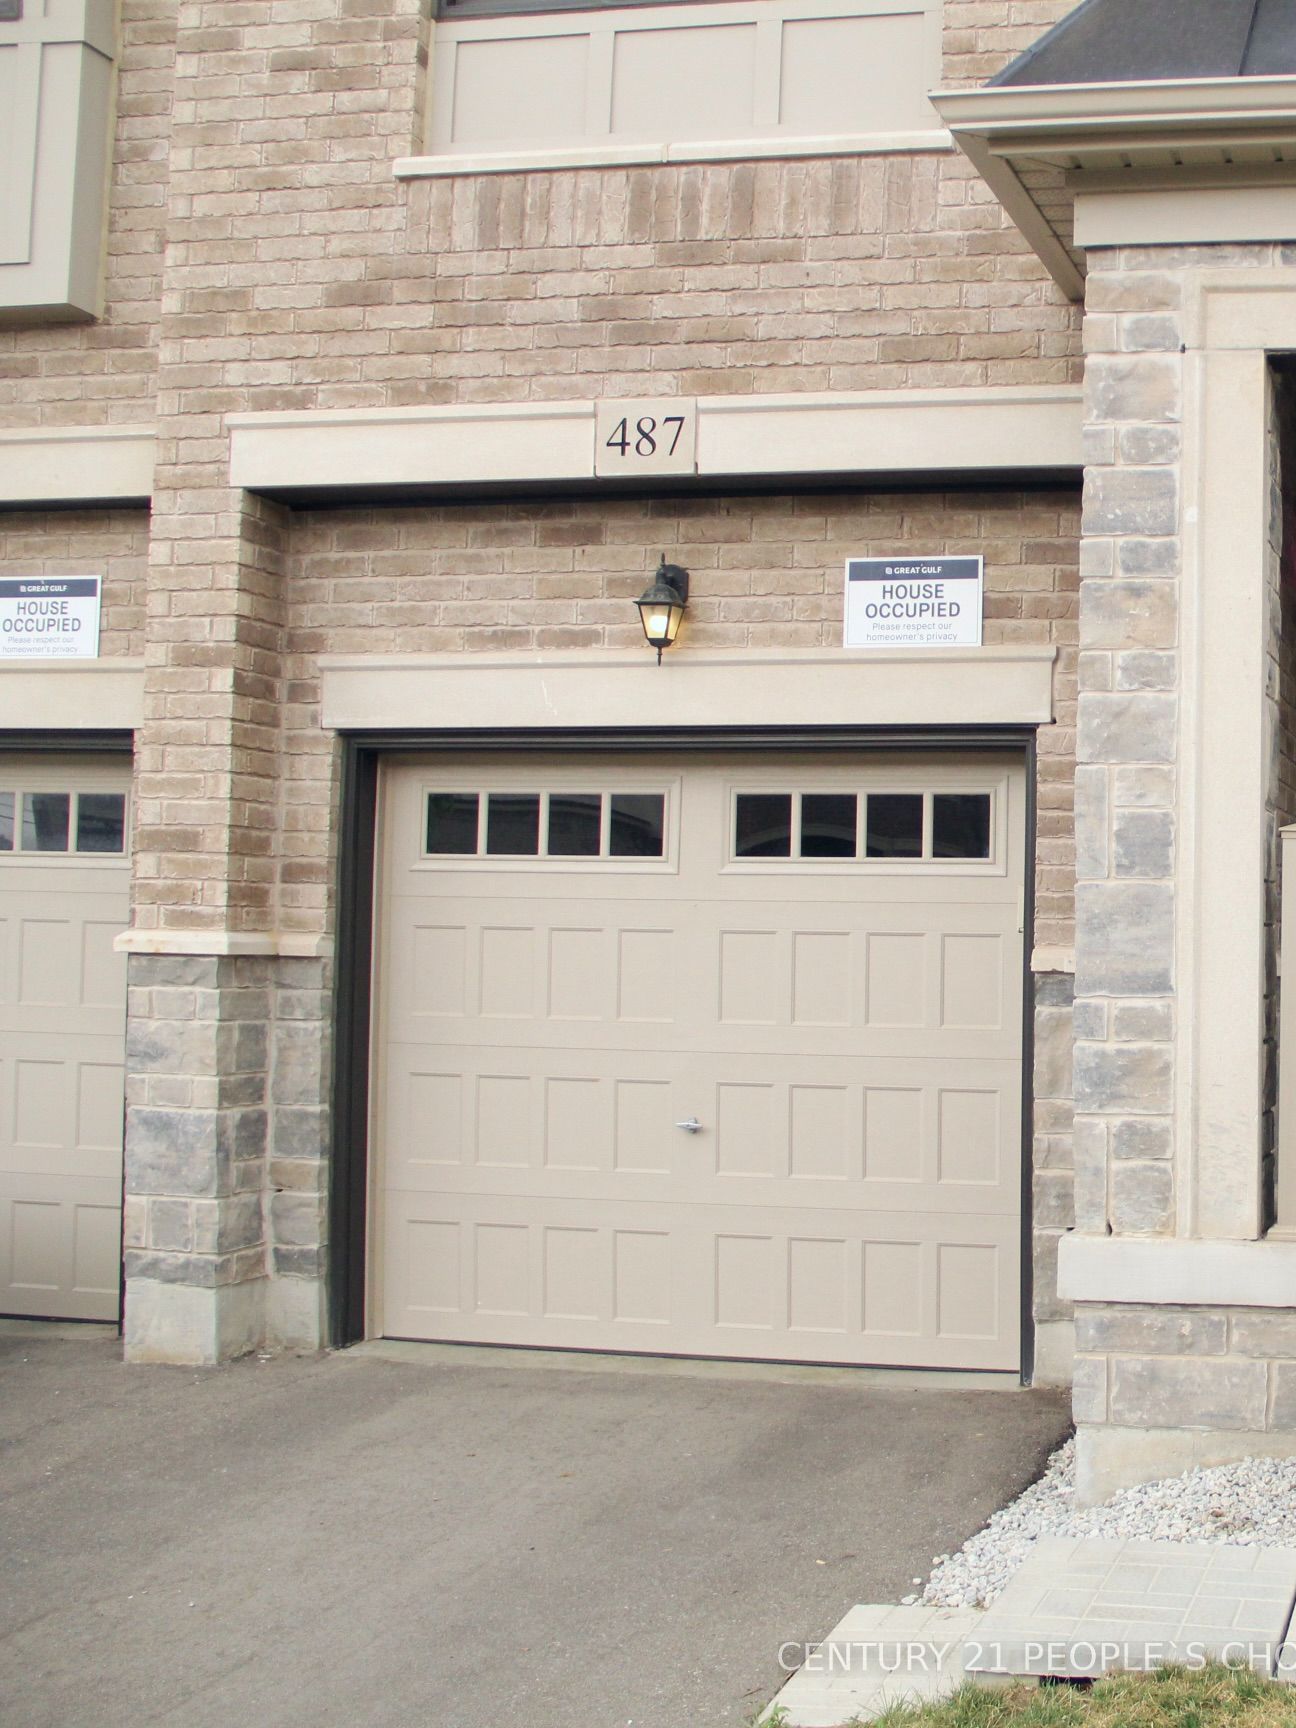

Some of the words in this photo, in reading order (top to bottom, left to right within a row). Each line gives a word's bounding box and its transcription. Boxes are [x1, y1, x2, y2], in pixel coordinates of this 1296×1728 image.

[606, 416, 686, 457] 487
[921, 566, 942, 574] GULF
[882, 583, 945, 600] HOUSE
[17, 601, 69, 615] HOUSE
[865, 602, 961, 619] OCCUPIED
[2, 618, 81, 632] OCCUPIED
[872, 622, 901, 631] Please
[902, 623, 935, 632] respect
[33, 636, 60, 645] respect
[866, 632, 924, 641] homeowner's
[926, 632, 958, 642] privacy
[2, 645, 50, 653] homeowner's
[52, 646, 78, 654] privacy
